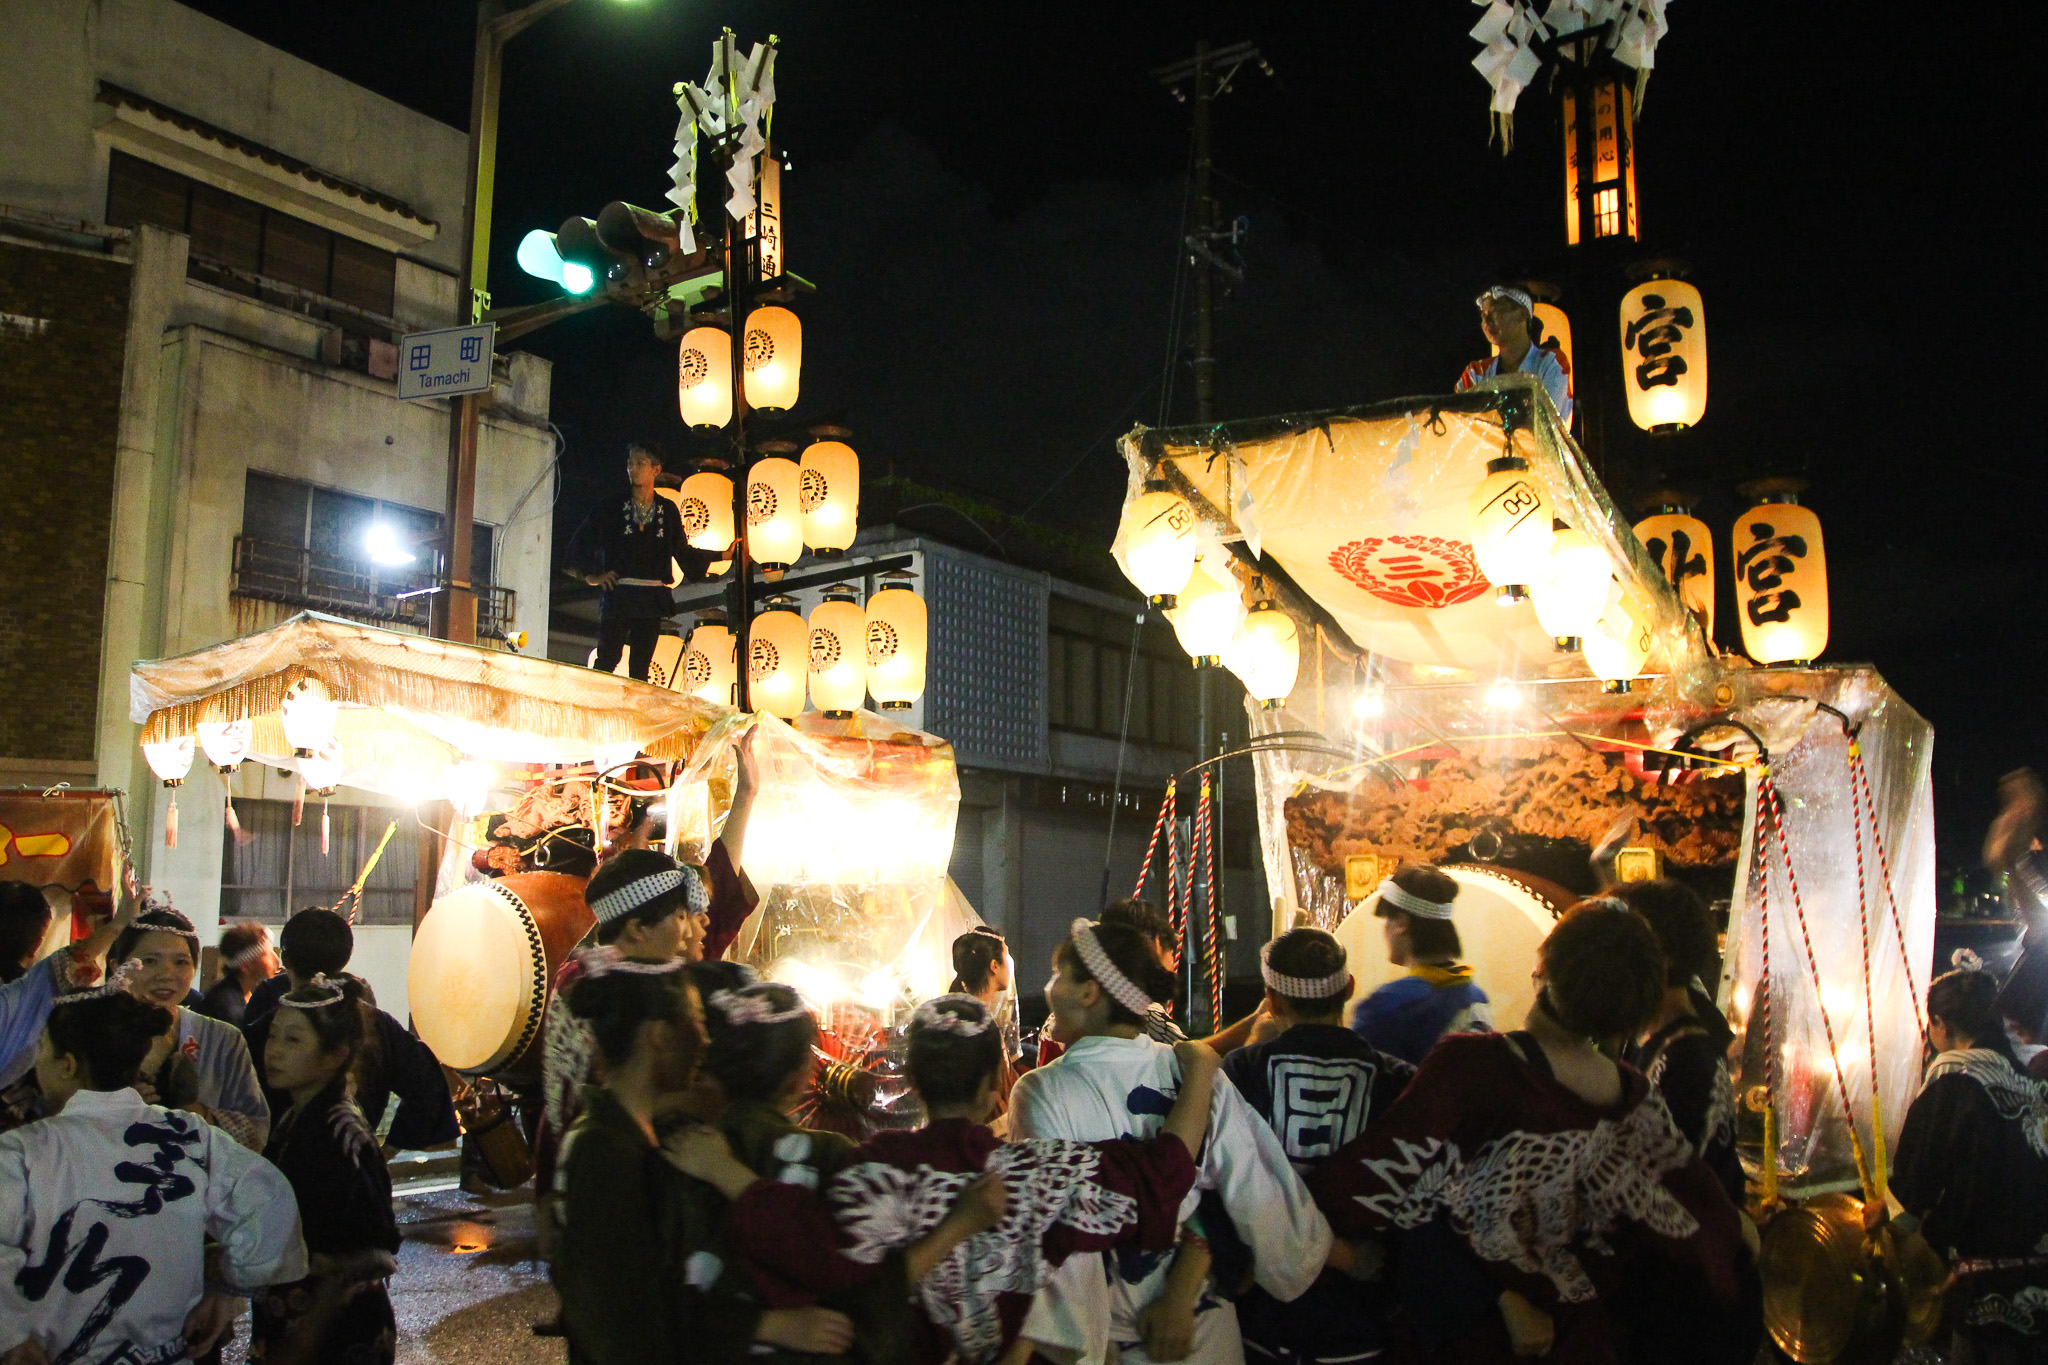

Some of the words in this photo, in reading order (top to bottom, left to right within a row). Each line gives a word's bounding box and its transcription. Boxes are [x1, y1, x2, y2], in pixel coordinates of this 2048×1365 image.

[760, 202, 778, 278] 三崎通
[410, 336, 483, 371] 田町
[419, 368, 471, 388] Tamachi
[1626, 294, 1694, 391] 宮
[1737, 523, 1807, 626] 宮
